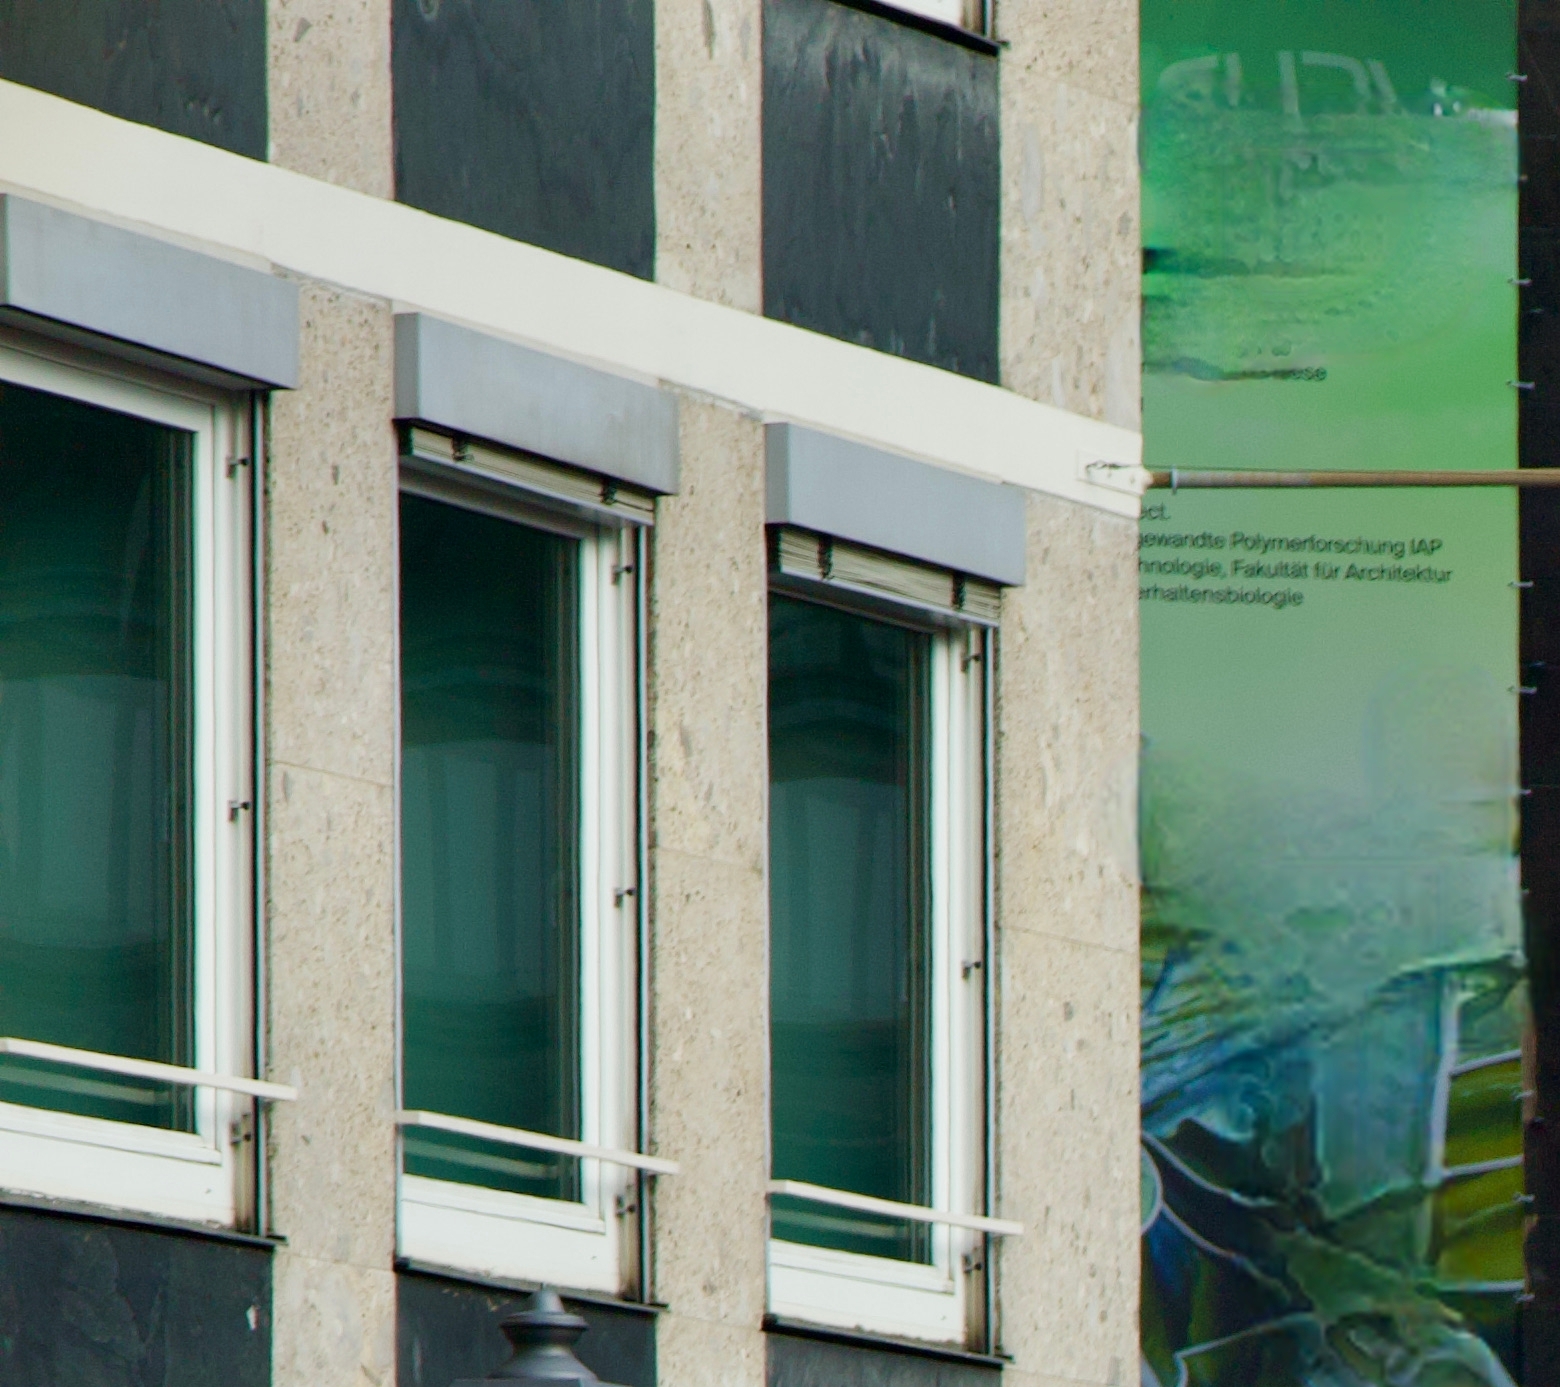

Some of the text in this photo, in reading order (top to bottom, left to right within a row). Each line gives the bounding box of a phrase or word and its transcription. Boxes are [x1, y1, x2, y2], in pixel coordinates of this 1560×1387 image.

[1230, 531, 1405, 560] Polymerforschung
[1409, 538, 1443, 556] IAP
[1231, 559, 1309, 580] Fakultät
[1313, 561, 1340, 580] für
[1344, 562, 1453, 583] Architektur
